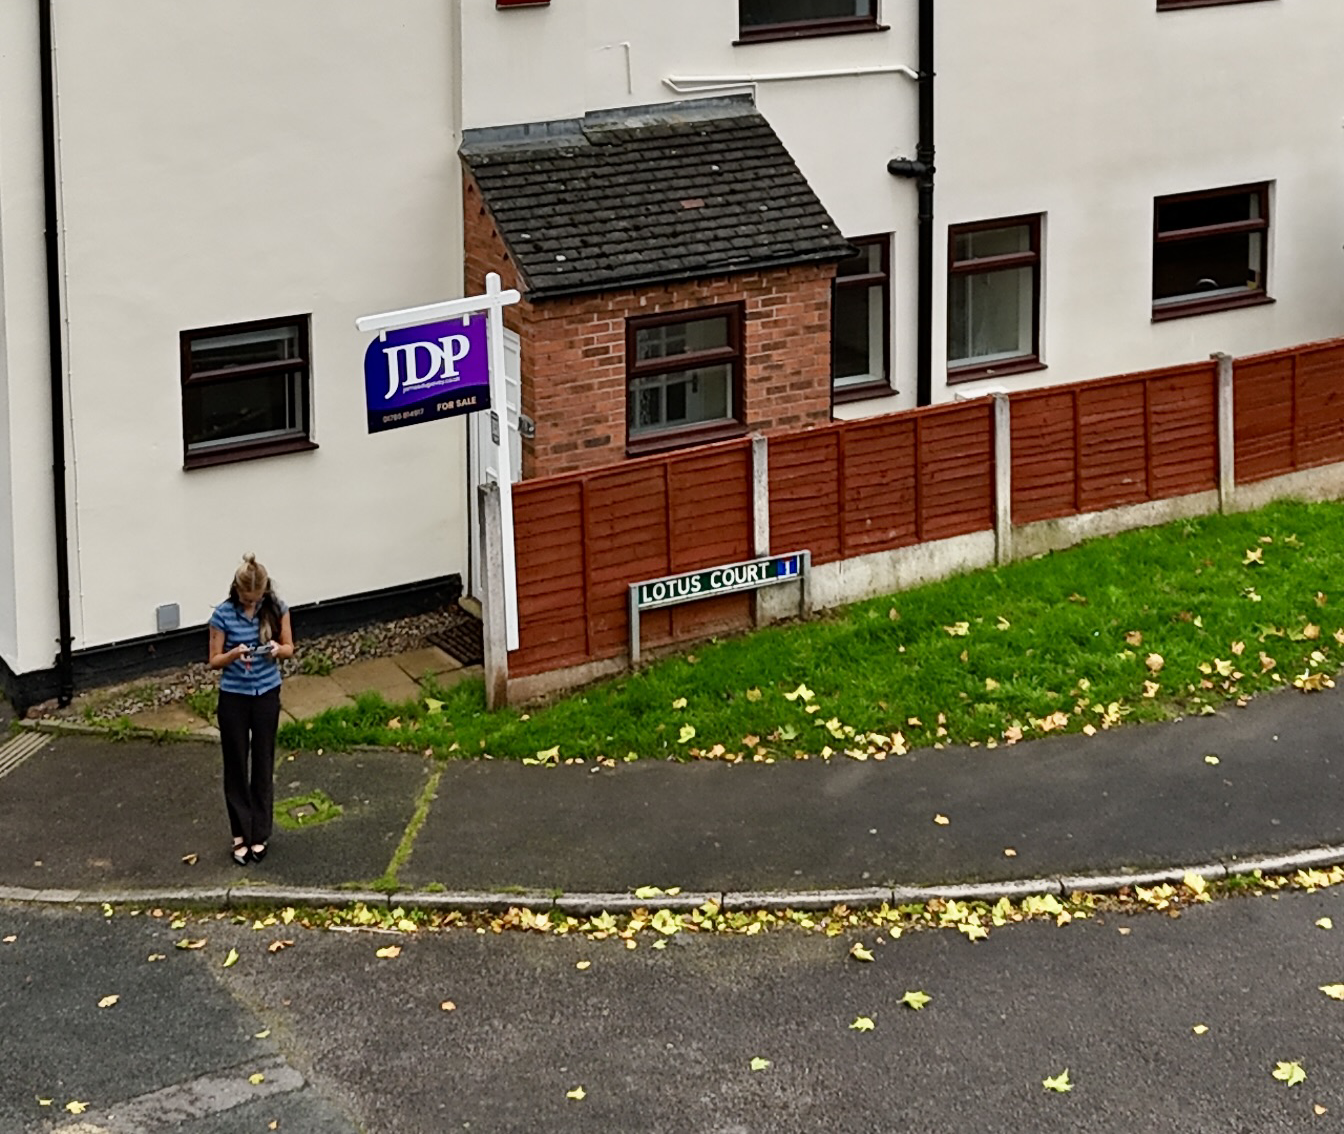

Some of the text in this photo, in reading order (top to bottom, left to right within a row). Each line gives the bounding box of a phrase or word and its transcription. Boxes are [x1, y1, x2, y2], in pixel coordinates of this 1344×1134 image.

[382, 334, 470, 399] JDP
[437, 396, 477, 412] FOR SALE
[642, 562, 770, 603] LOTUS COURT
